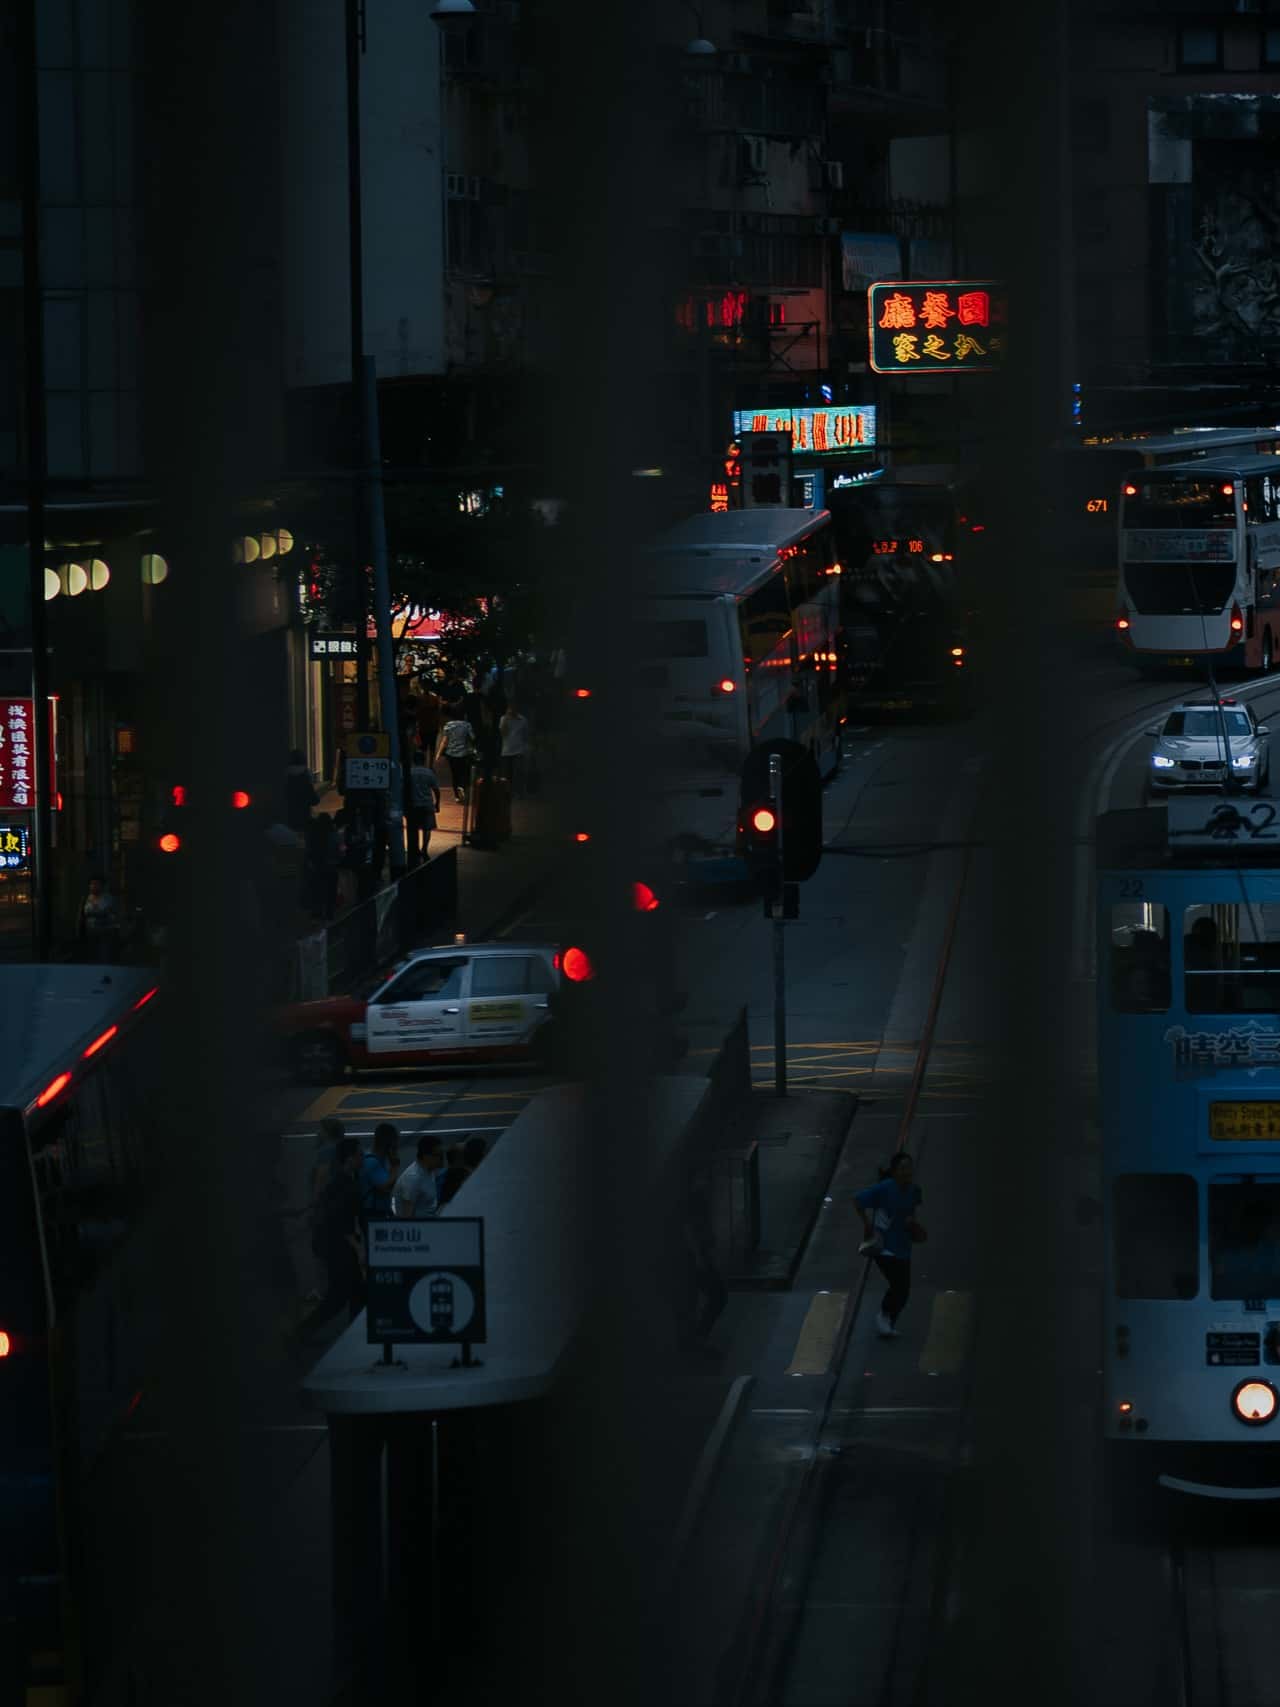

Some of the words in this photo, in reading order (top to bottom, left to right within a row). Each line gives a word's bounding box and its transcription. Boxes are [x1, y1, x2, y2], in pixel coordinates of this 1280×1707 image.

[1087, 499, 1107, 512] 671
[1211, 804, 1277, 838] 22
[1119, 880, 1144, 898] 22
